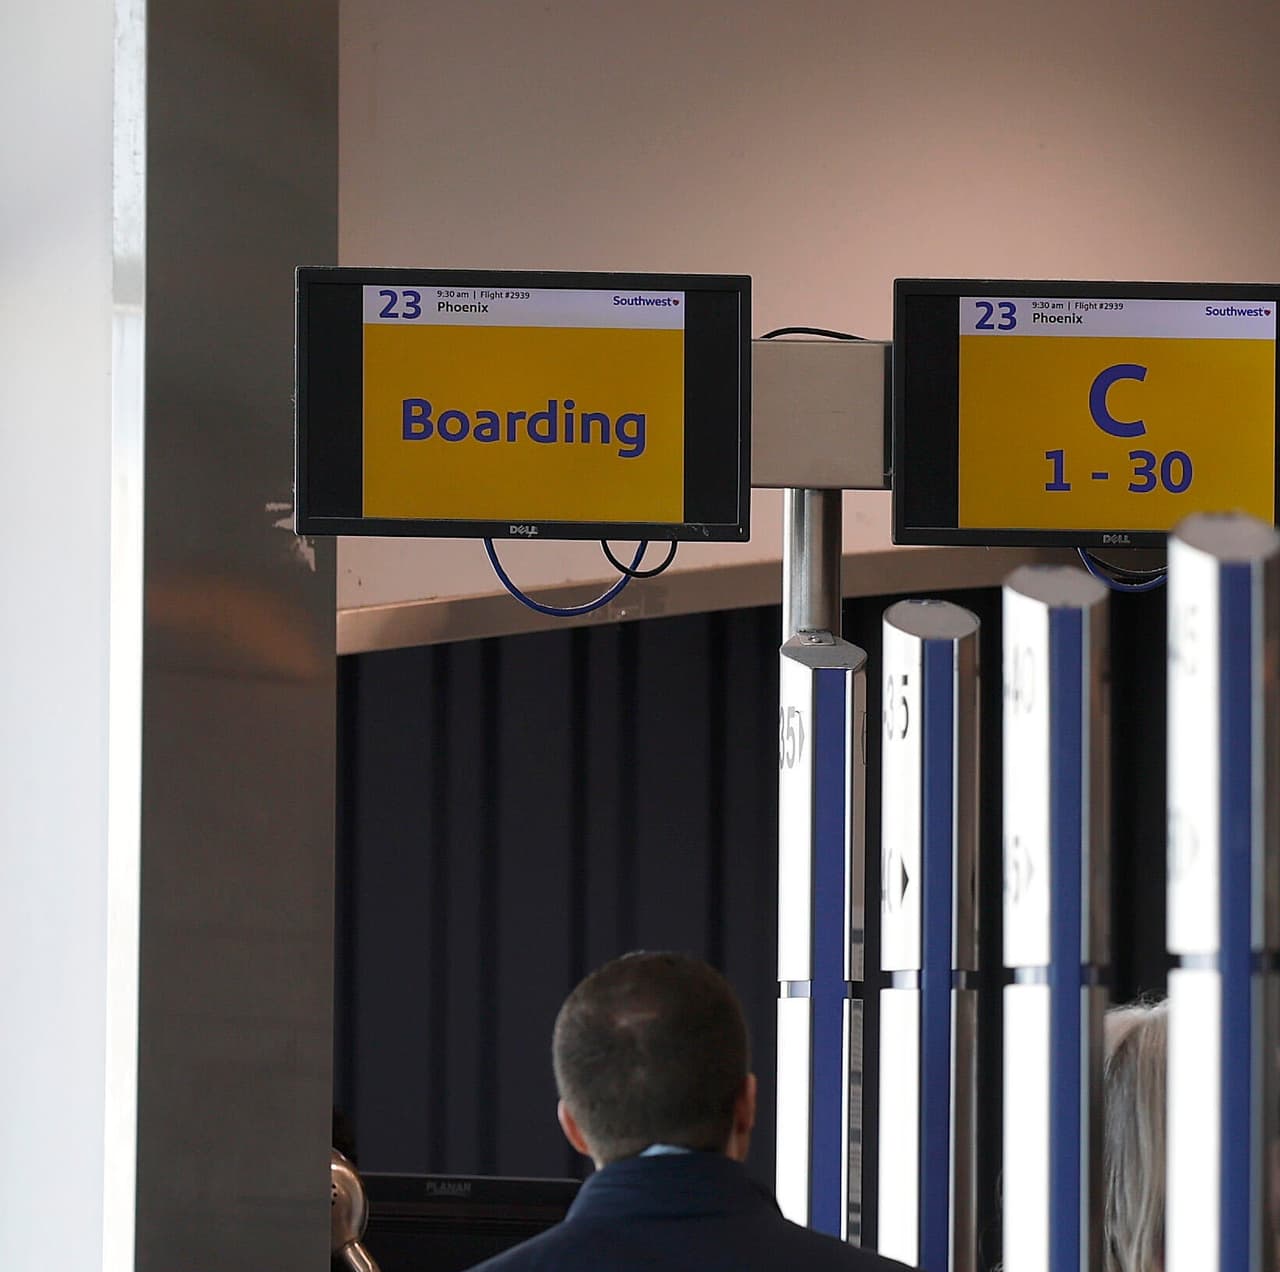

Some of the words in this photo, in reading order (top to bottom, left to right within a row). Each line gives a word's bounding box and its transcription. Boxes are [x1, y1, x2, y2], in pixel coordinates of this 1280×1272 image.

[437, 290, 455, 298] 9:30
[481, 291, 503, 300] Flight
[505, 291, 530, 299] #2939
[379, 290, 421, 319] 23
[437, 302, 488, 313] Phoenix
[613, 295, 672, 308] Southwest
[1032, 301, 1050, 309] 9:30
[1075, 302, 1098, 311] Flight
[1099, 302, 1124, 310] #2939
[976, 301, 1017, 331] 23
[1033, 312, 1083, 324] Phoenix
[1205, 306, 1264, 318] Southwest
[1089, 363, 1147, 438] C
[402, 398, 646, 458] Boarding
[1045, 449, 1071, 492] 1
[1128, 450, 1193, 494] 30
[510, 525, 538, 535] DELL
[1103, 534, 1131, 544] DELL
